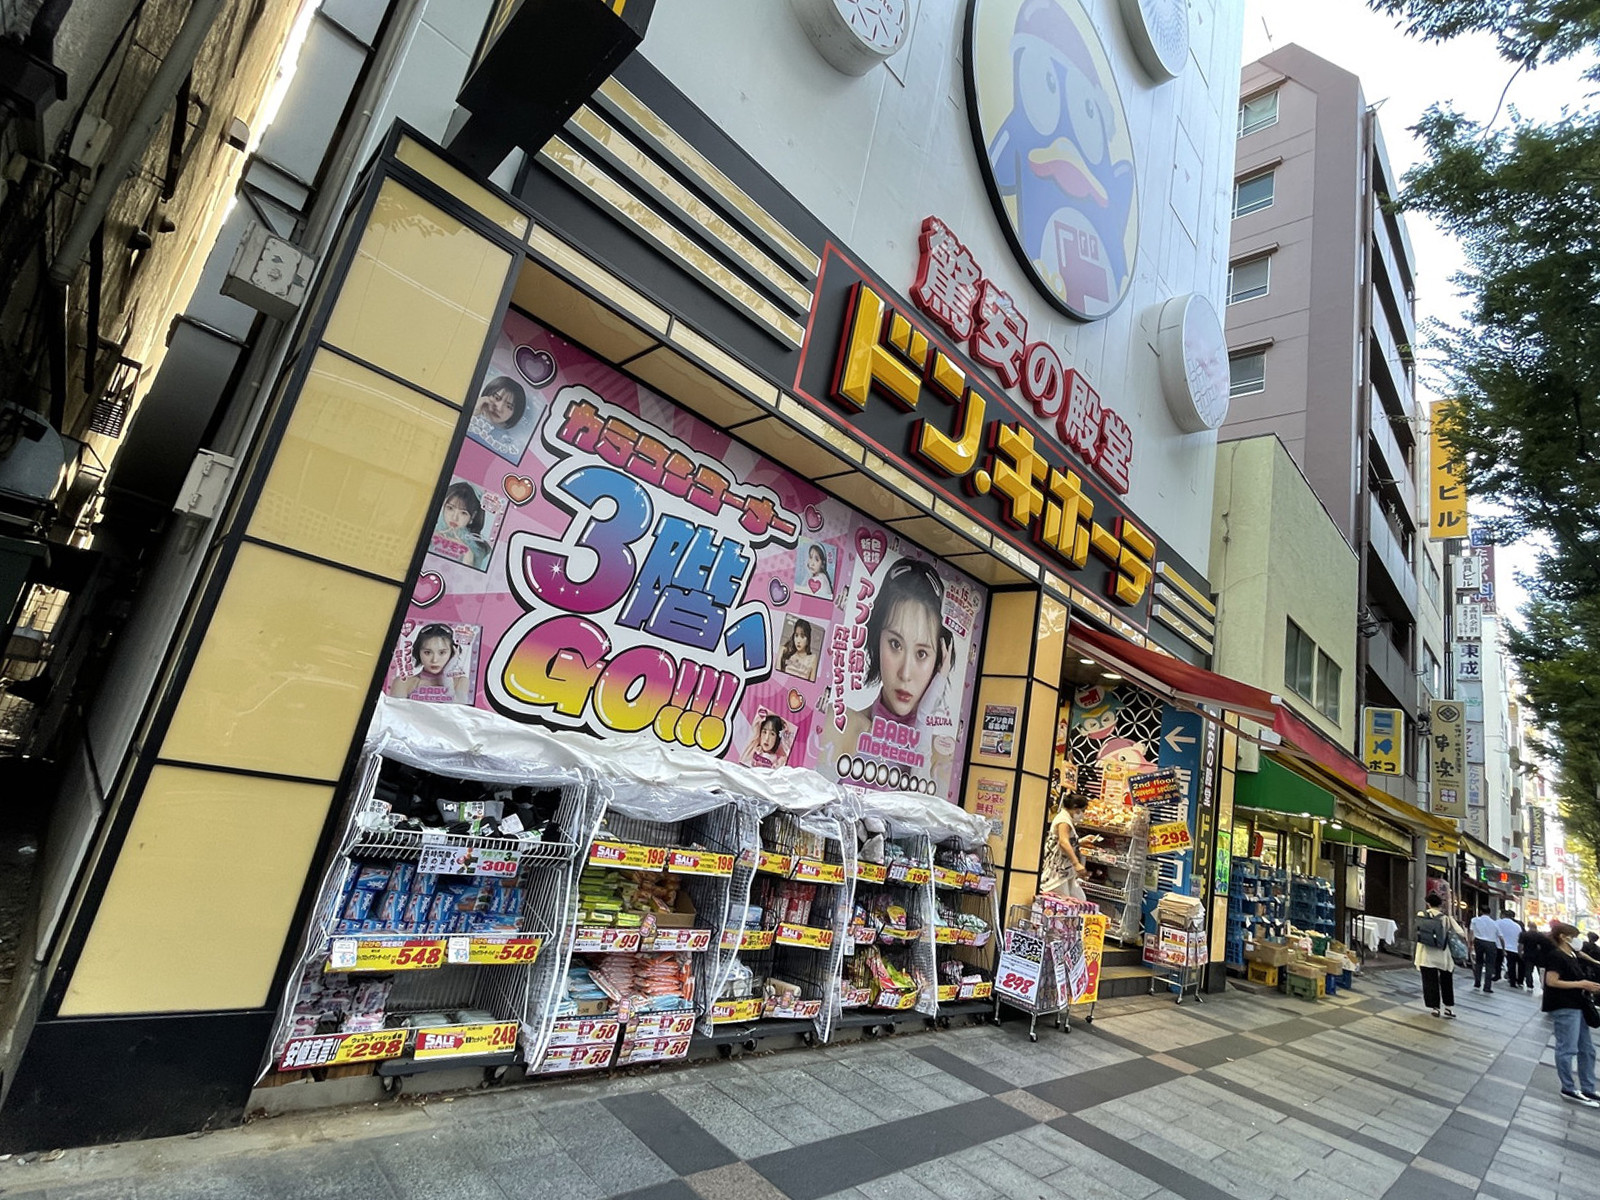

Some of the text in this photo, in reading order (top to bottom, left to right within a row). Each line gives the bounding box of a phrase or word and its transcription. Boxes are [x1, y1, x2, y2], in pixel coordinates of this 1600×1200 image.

[910, 215, 1134, 494] 驚安の殿堂
[559, 398, 797, 537] カラコンコーナー
[522, 465, 768, 672] 3階へ
[1459, 645, 1480, 676] 東成
[503, 613, 740, 751] GO!!!
[872, 717, 921, 749] BABY
[1132, 782, 1151, 790] 2nd
[1160, 830, 1190, 846] 298
[597, 845, 665, 865] SALE 198
[674, 854, 695, 867] SALE
[717, 855, 734, 871] 198
[481, 860, 517, 873] 300
[619, 934, 640, 949] 99
[691, 935, 709, 948] 99
[396, 947, 442, 966] 548
[499, 945, 538, 960] 548
[1002, 972, 1036, 994] 298
[595, 1024, 618, 1040] 58
[675, 1018, 694, 1033] 58
[424, 1034, 455, 1047] SALE
[492, 1025, 516, 1045] 248
[350, 1040, 402, 1058] 298
[670, 1041, 690, 1055] 58
[589, 1049, 612, 1065] 58
